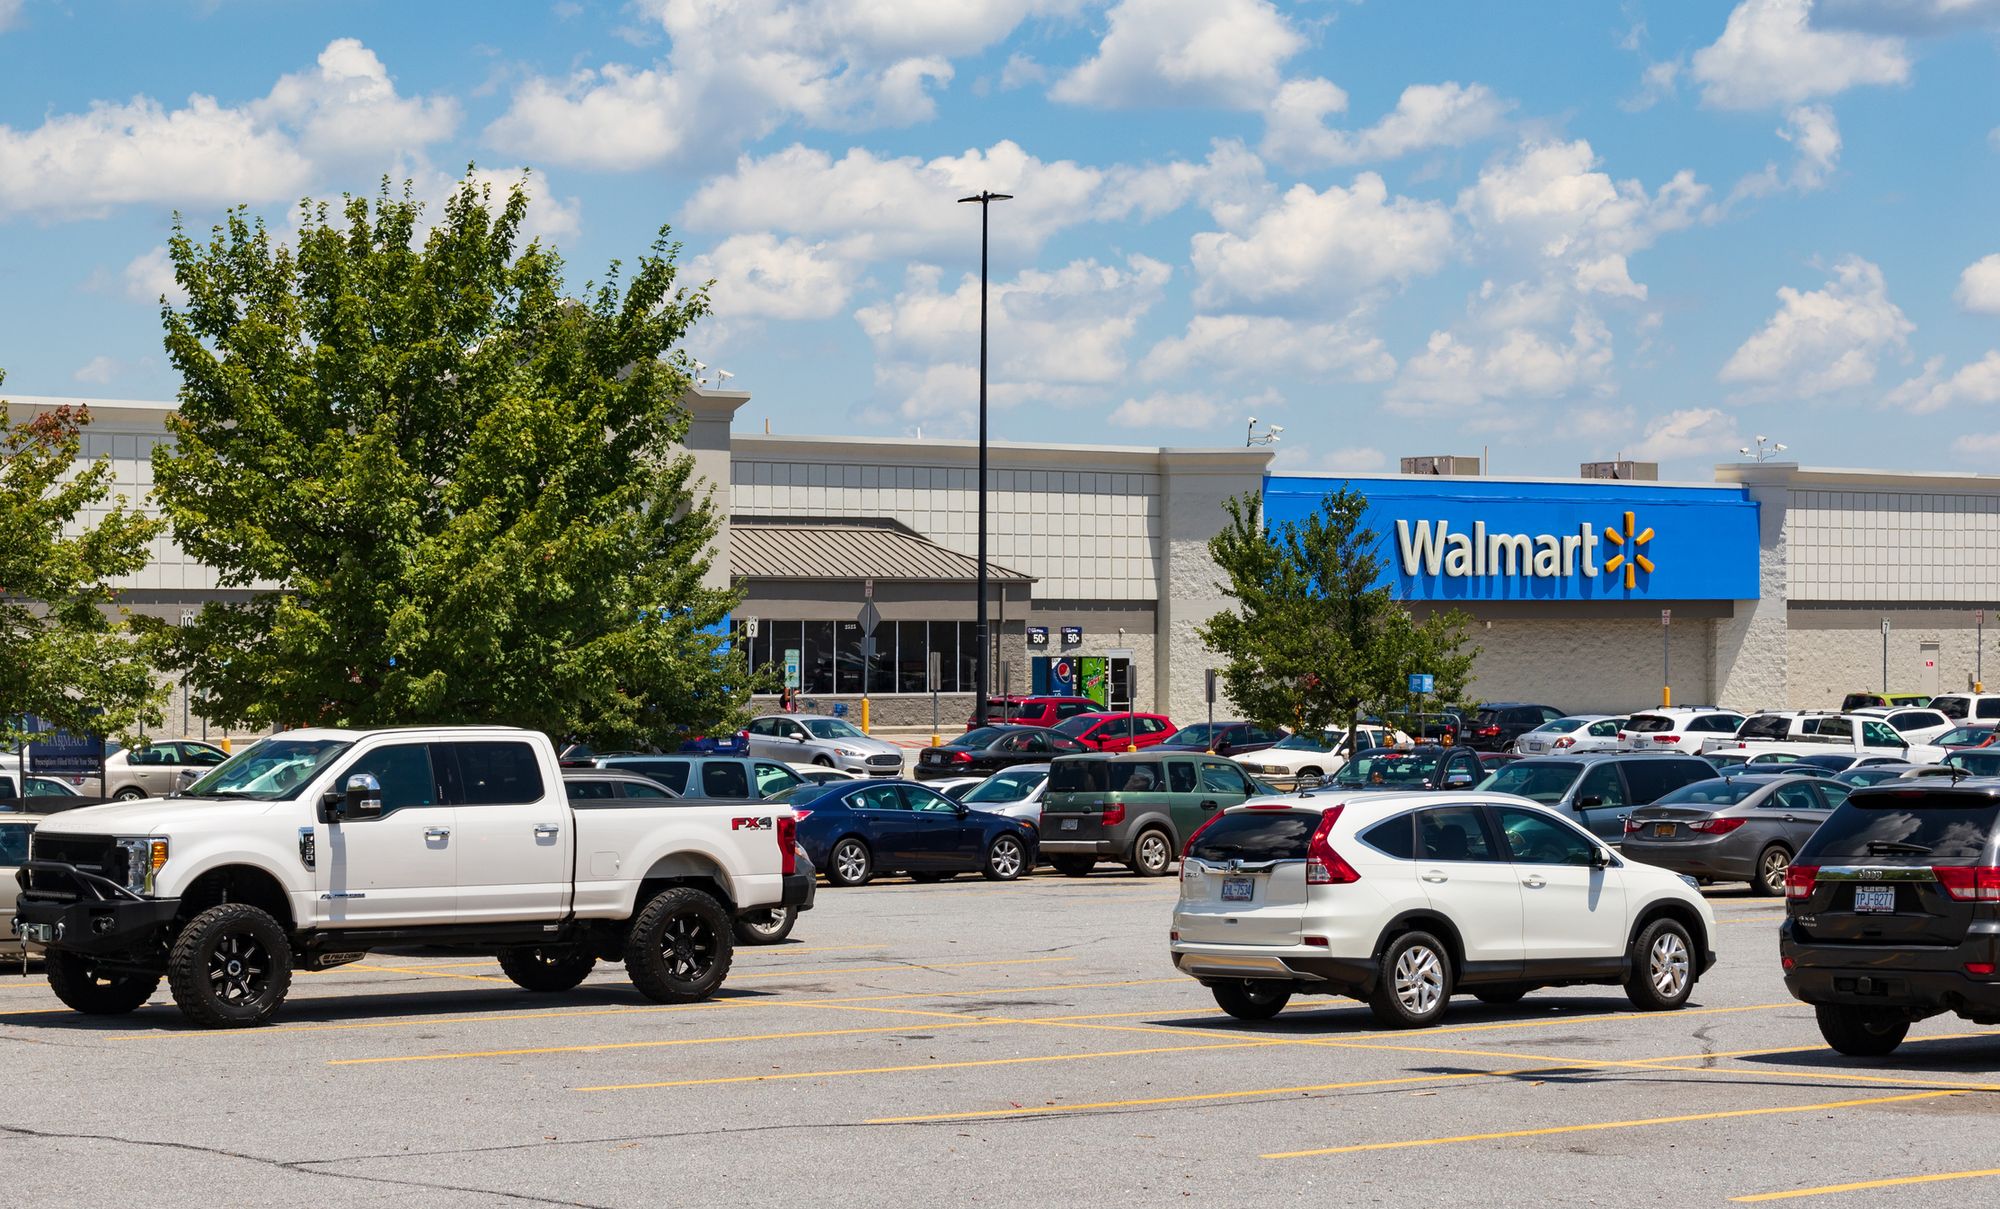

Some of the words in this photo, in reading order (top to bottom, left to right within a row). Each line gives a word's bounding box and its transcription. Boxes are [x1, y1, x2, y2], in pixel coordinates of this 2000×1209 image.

[1396, 519, 1599, 577] Walmart
[182, 616, 193, 628] 10
[750, 623, 756, 636] 9
[731, 817, 773, 831] FX4
[1859, 869, 1882, 880] Jeep
